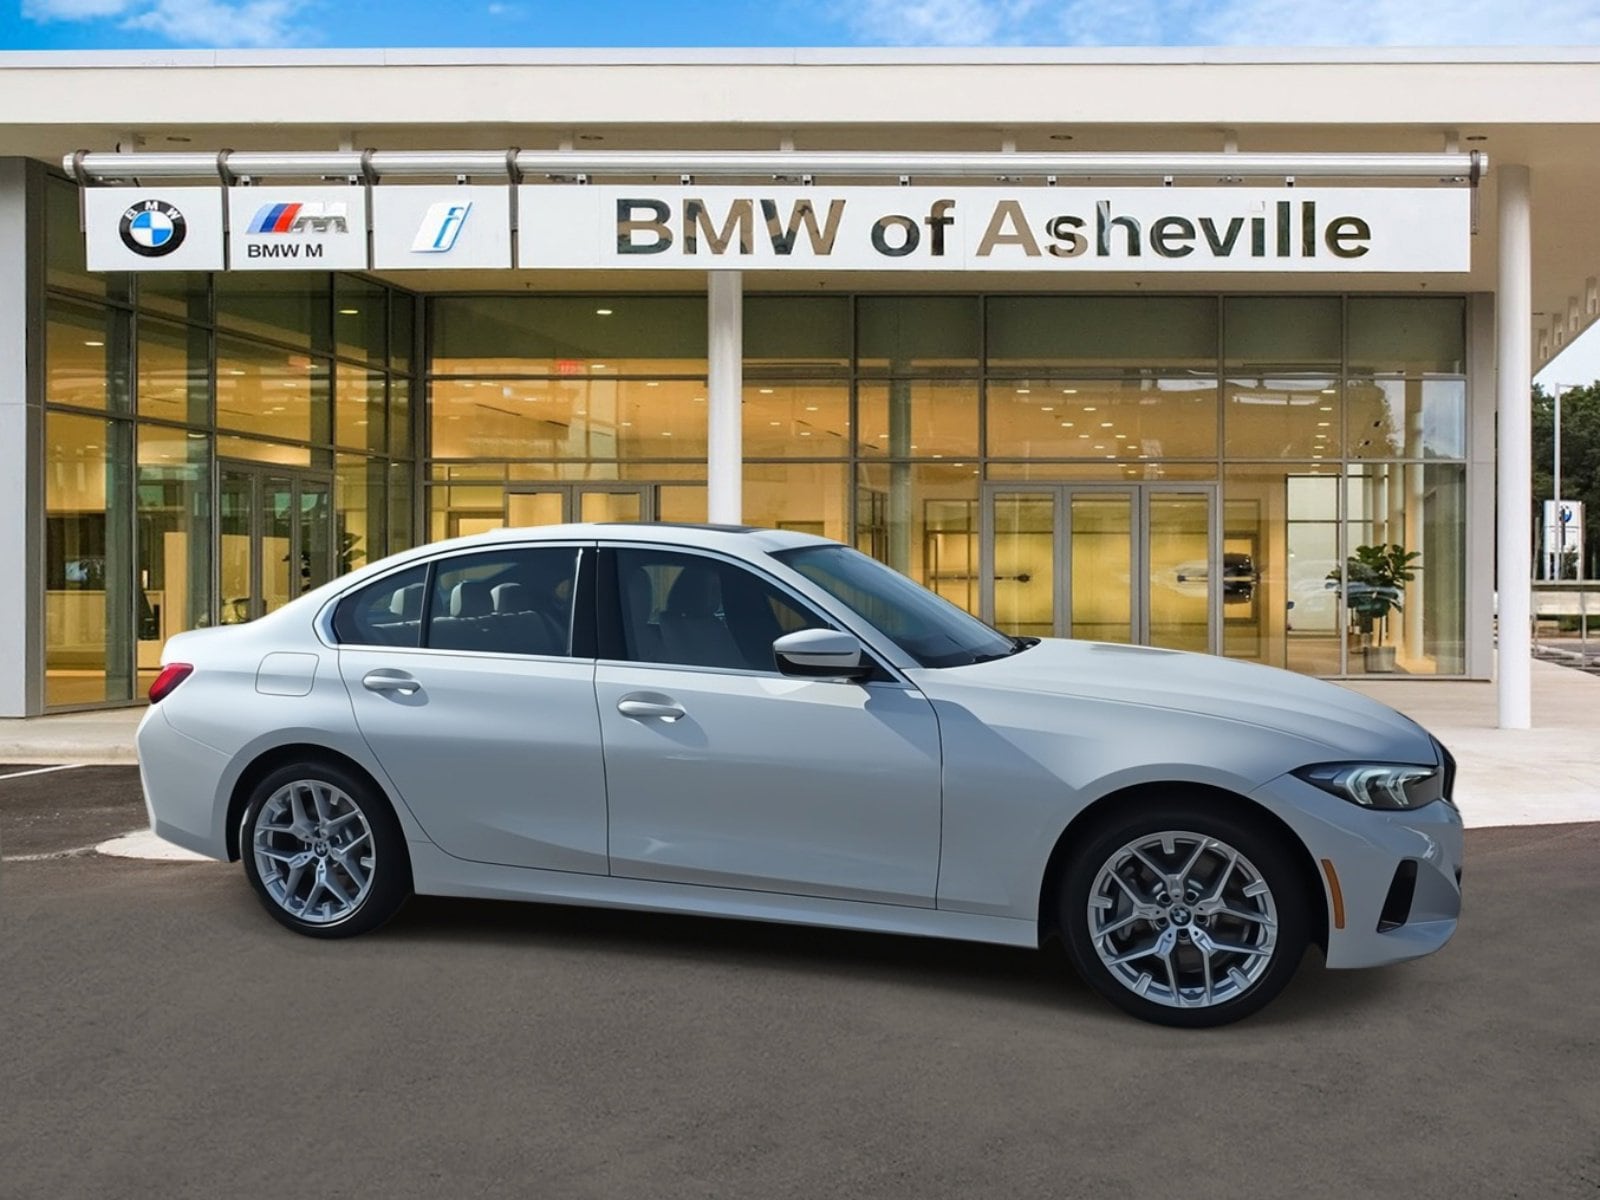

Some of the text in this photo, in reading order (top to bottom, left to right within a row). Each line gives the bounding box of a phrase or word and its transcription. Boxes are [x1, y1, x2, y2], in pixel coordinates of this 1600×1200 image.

[125, 200, 181, 220] BMW
[616, 198, 1371, 258] BMW of Asheville
[247, 244, 323, 258] BMW M
